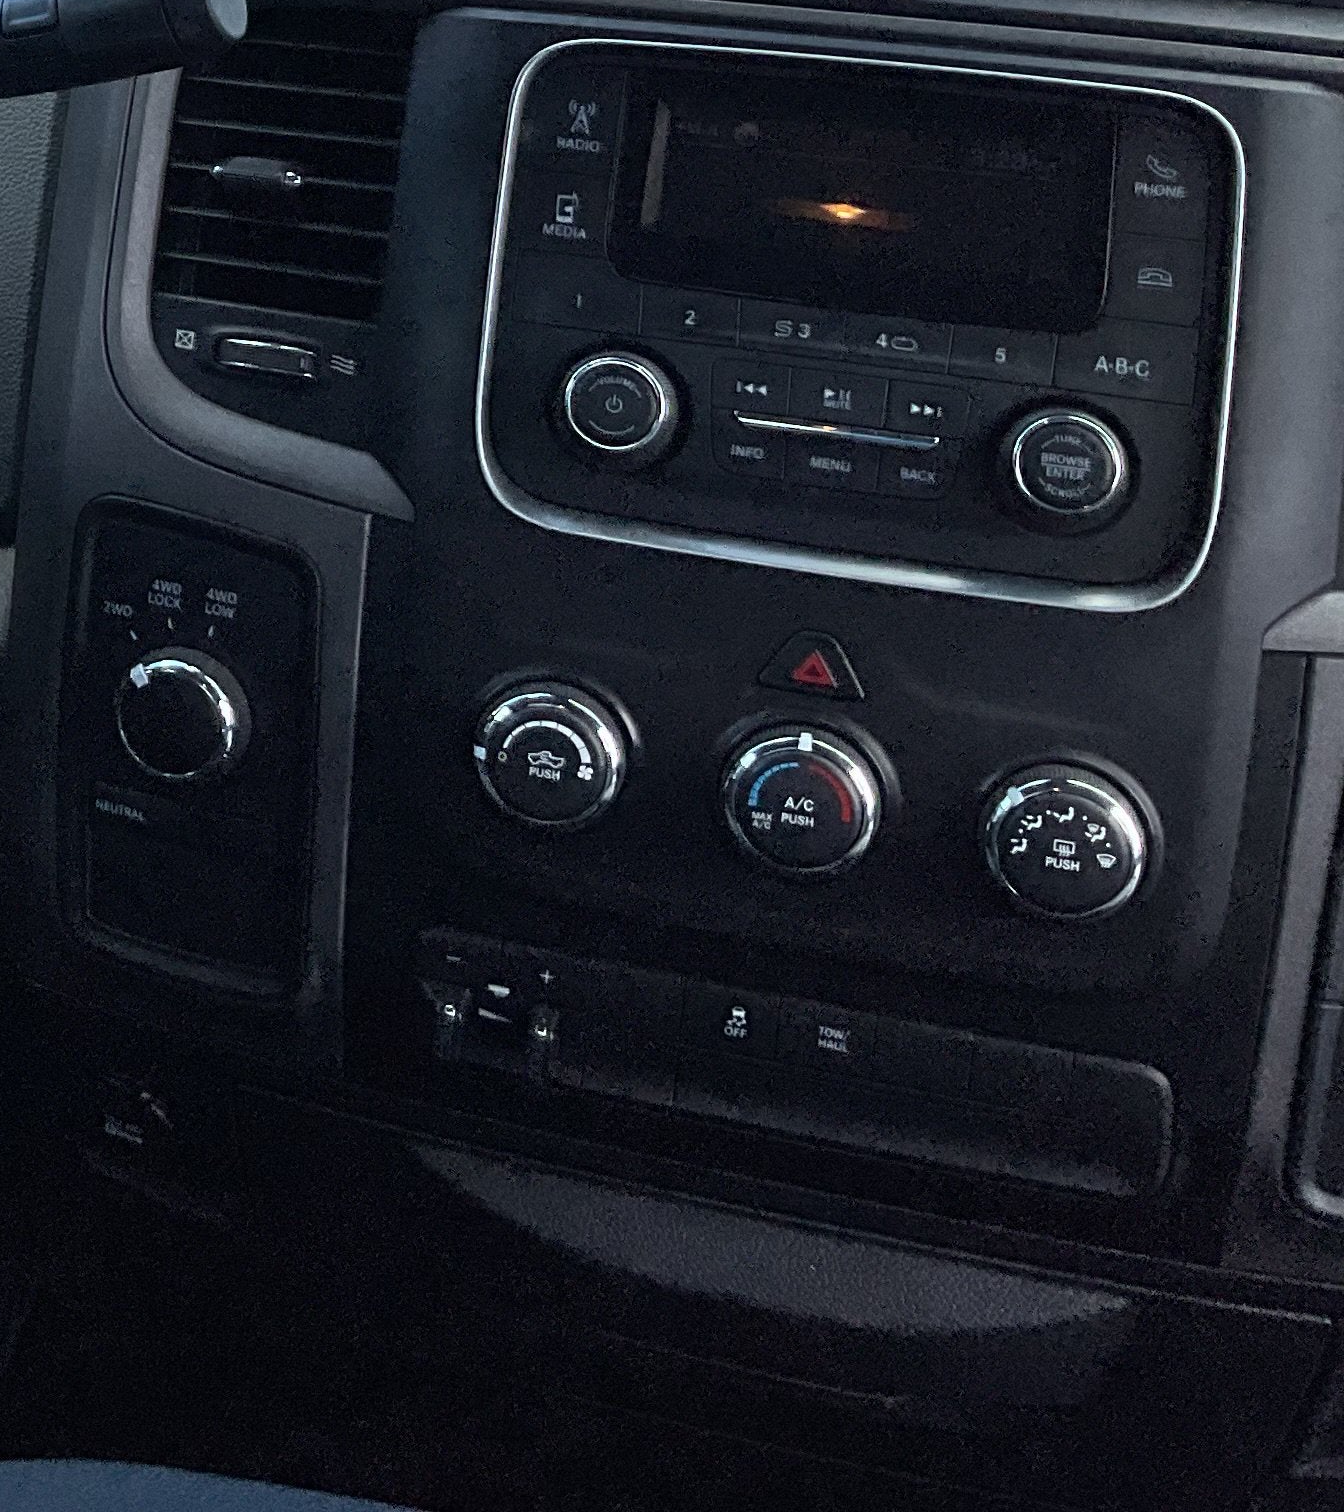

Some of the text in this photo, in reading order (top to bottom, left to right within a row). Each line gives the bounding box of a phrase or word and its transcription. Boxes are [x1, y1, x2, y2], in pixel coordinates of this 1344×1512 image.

[556, 138, 600, 153] RADIO
[1134, 182, 1185, 199] PHONE
[542, 223, 586, 239] MEDIA
[576, 293, 583, 309] 1
[685, 310, 697, 325] 2
[798, 323, 811, 338] 3
[876, 334, 887, 348] 4
[995, 348, 1006, 363] 5
[730, 444, 767, 460] INFO
[1041, 452, 1091, 467] BROWSE
[810, 456, 852, 472] MENU
[900, 467, 936, 483] BACK
[1046, 466, 1085, 480] ENTER
[151, 579, 182, 595] 4WD
[148, 591, 182, 610] LOCK
[206, 588, 238, 605] 4WD
[103, 600, 133, 618] 2WD
[205, 602, 237, 619] LOW
[529, 766, 560, 781] PUSH
[95, 797, 145, 822] NEUTRAL
[784, 796, 815, 811] A/C
[752, 811, 772, 821] MAX
[780, 812, 815, 828] PUSH
[752, 820, 771, 829] A/C
[1045, 855, 1080, 872] PUSH
[724, 1026, 747, 1038] OFF
[818, 1038, 848, 1052] HAUL
